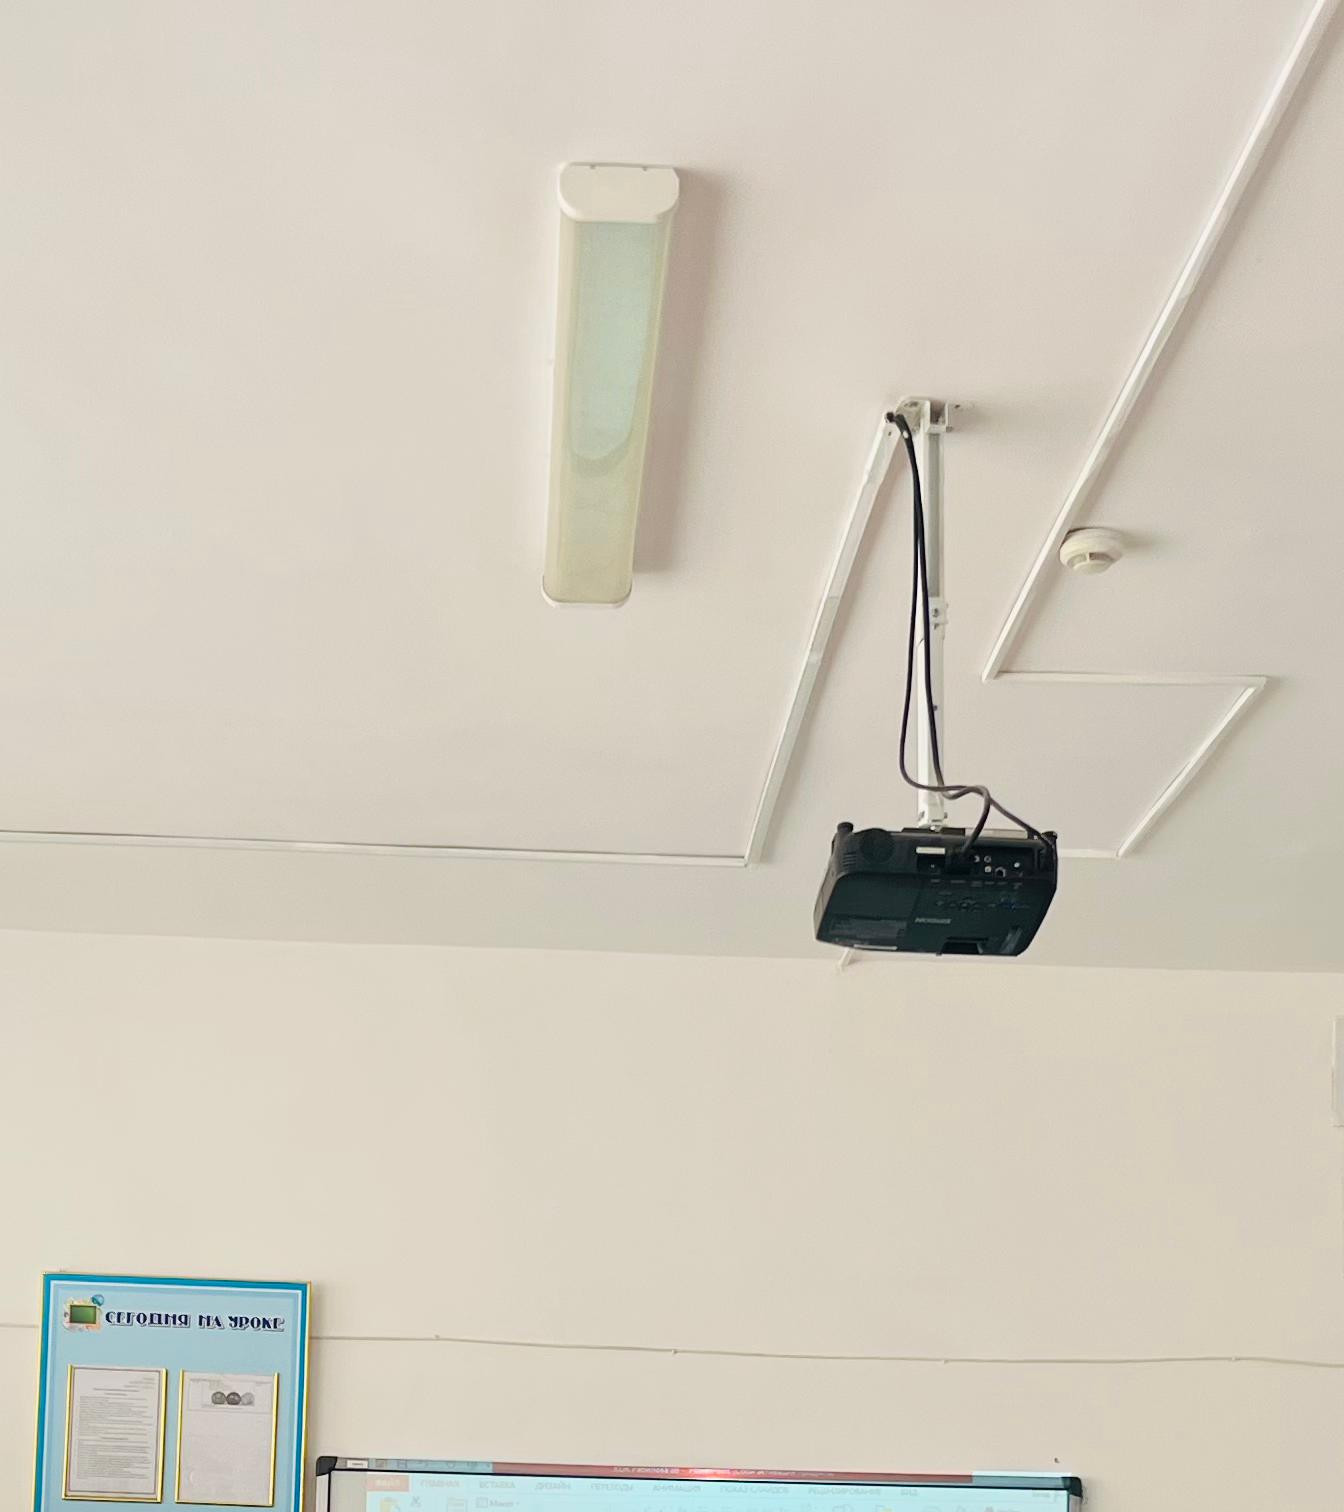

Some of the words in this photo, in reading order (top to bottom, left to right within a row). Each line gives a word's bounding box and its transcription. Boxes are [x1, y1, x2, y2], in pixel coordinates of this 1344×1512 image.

[105, 1311, 191, 1328] СЕГОДНЯ
[198, 1315, 225, 1329] НА
[228, 1315, 284, 1331] УРОКЕ
